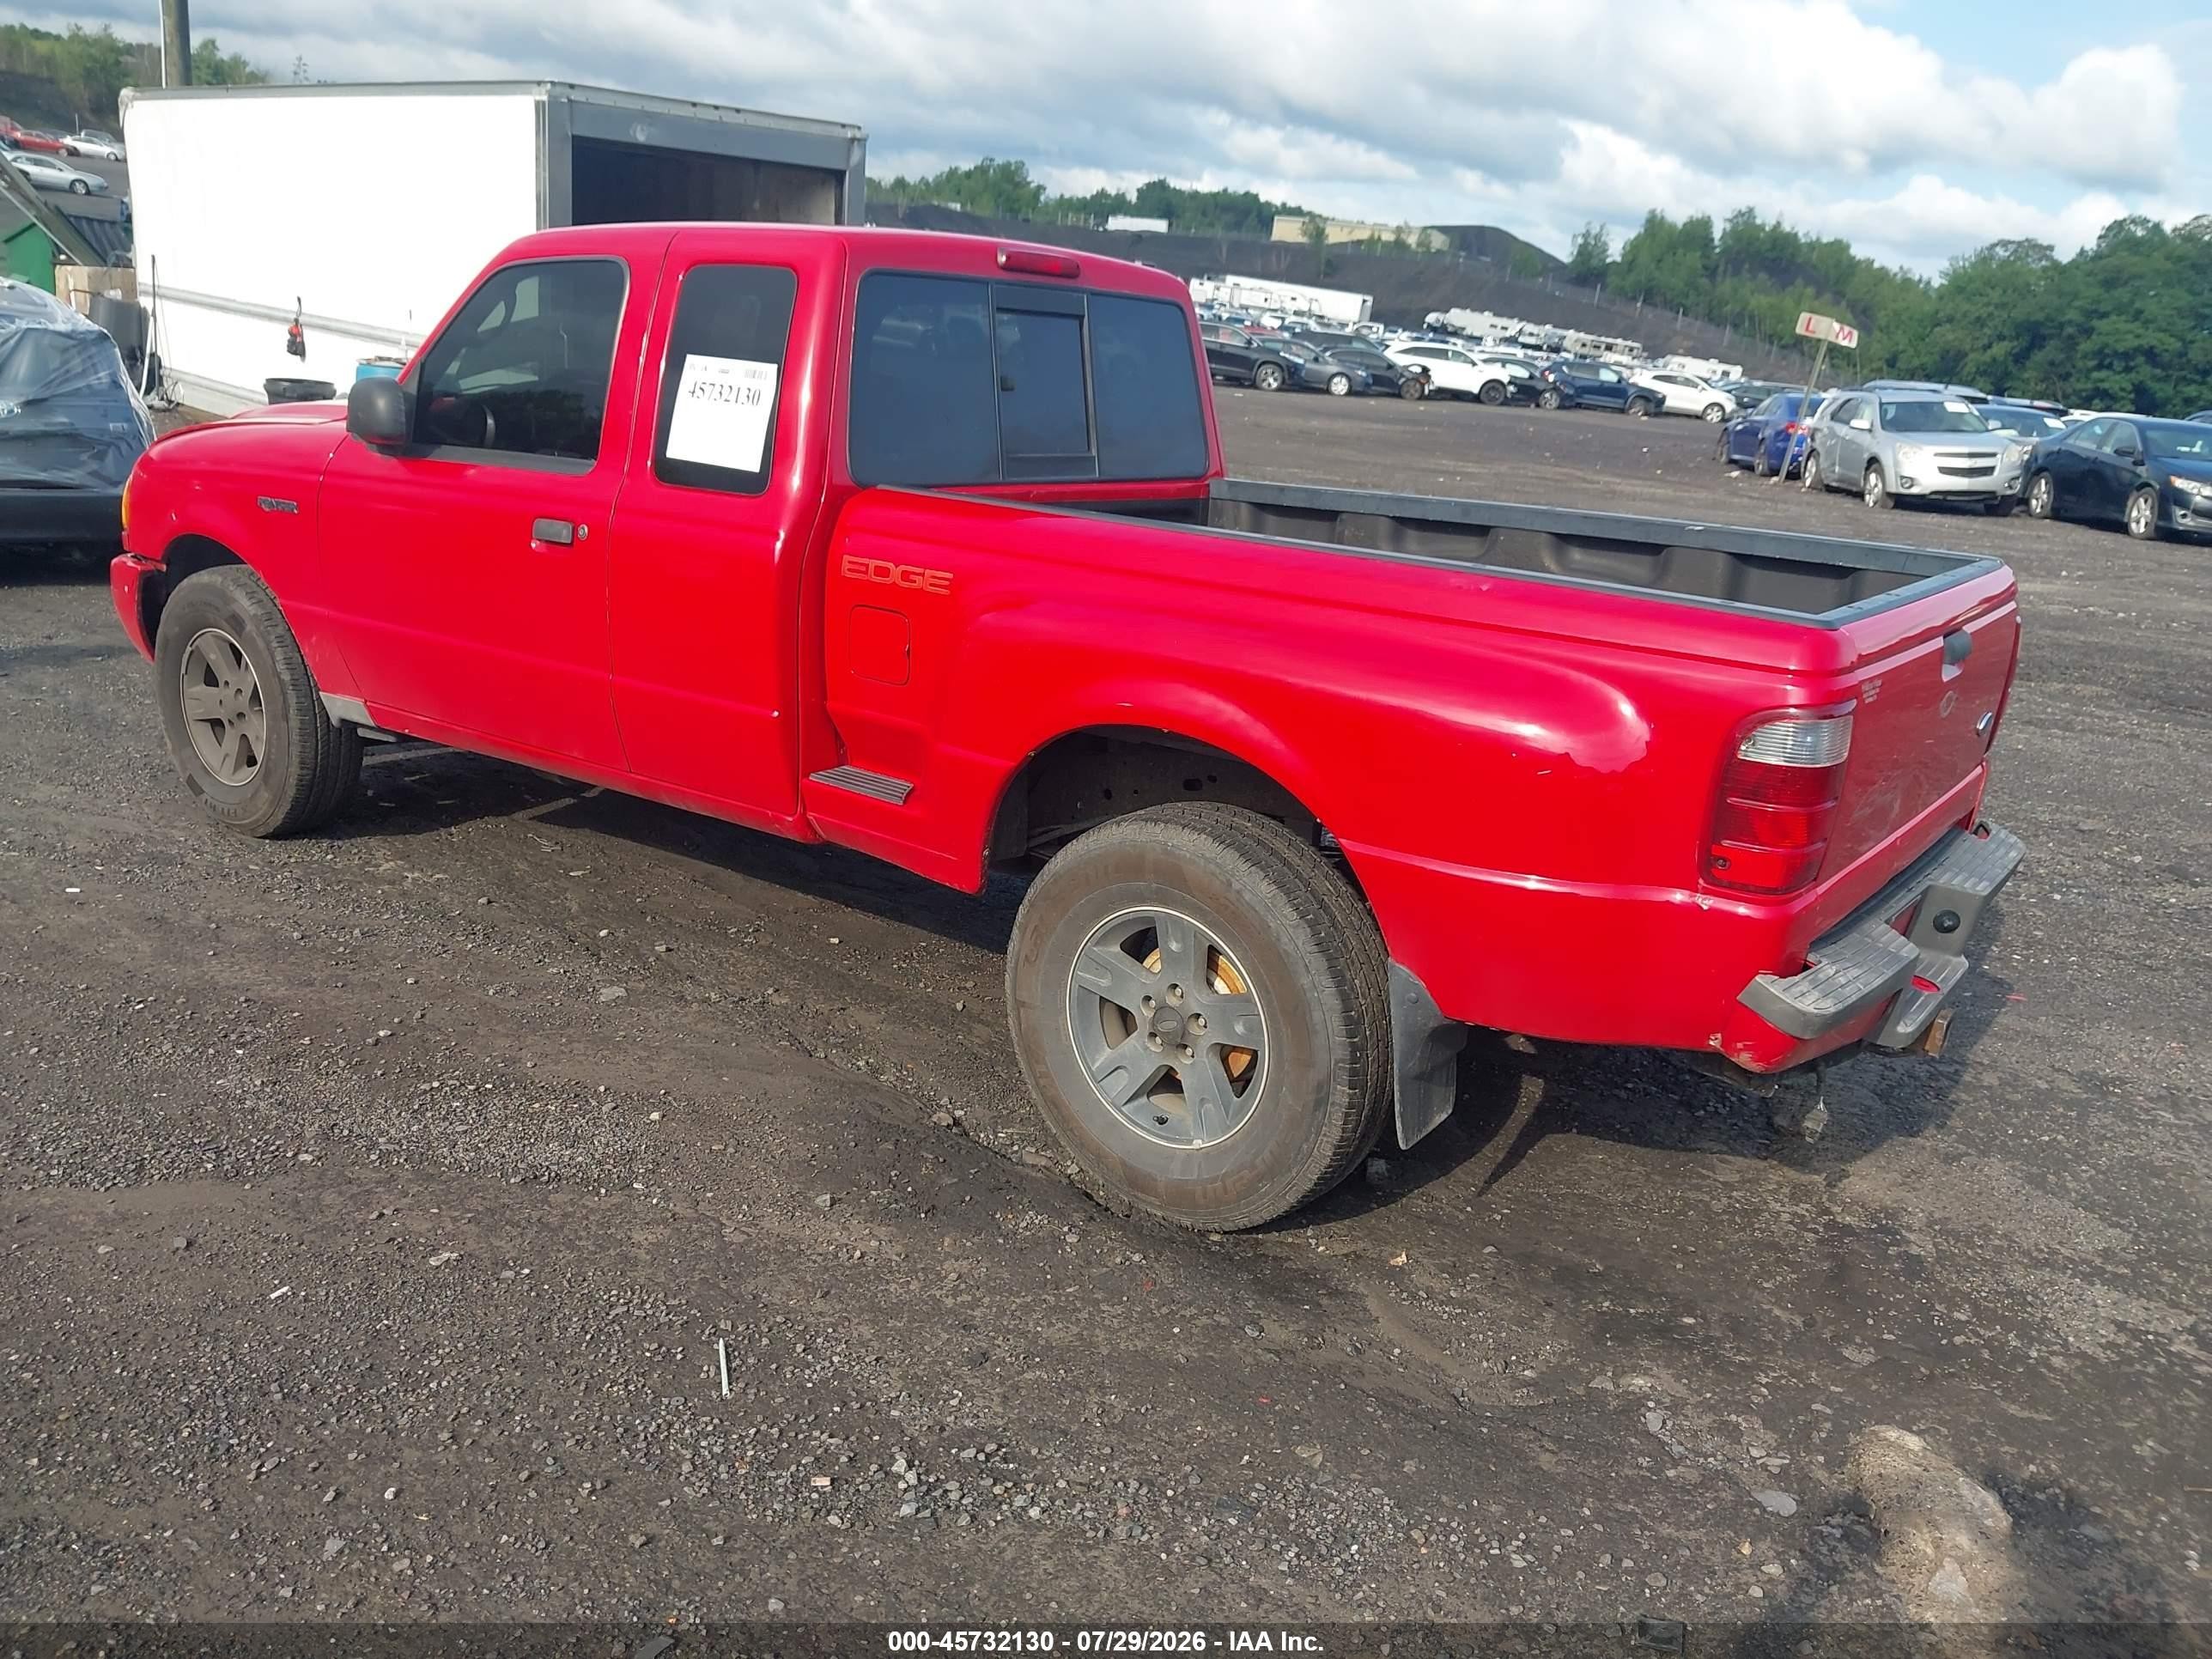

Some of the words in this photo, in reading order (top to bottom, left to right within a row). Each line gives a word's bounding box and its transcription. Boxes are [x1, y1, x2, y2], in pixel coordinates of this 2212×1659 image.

[1805, 316, 1815, 334] L
[1835, 326, 1853, 343] M
[688, 380, 762, 406] 45732130
[841, 555, 954, 595] EDGE
